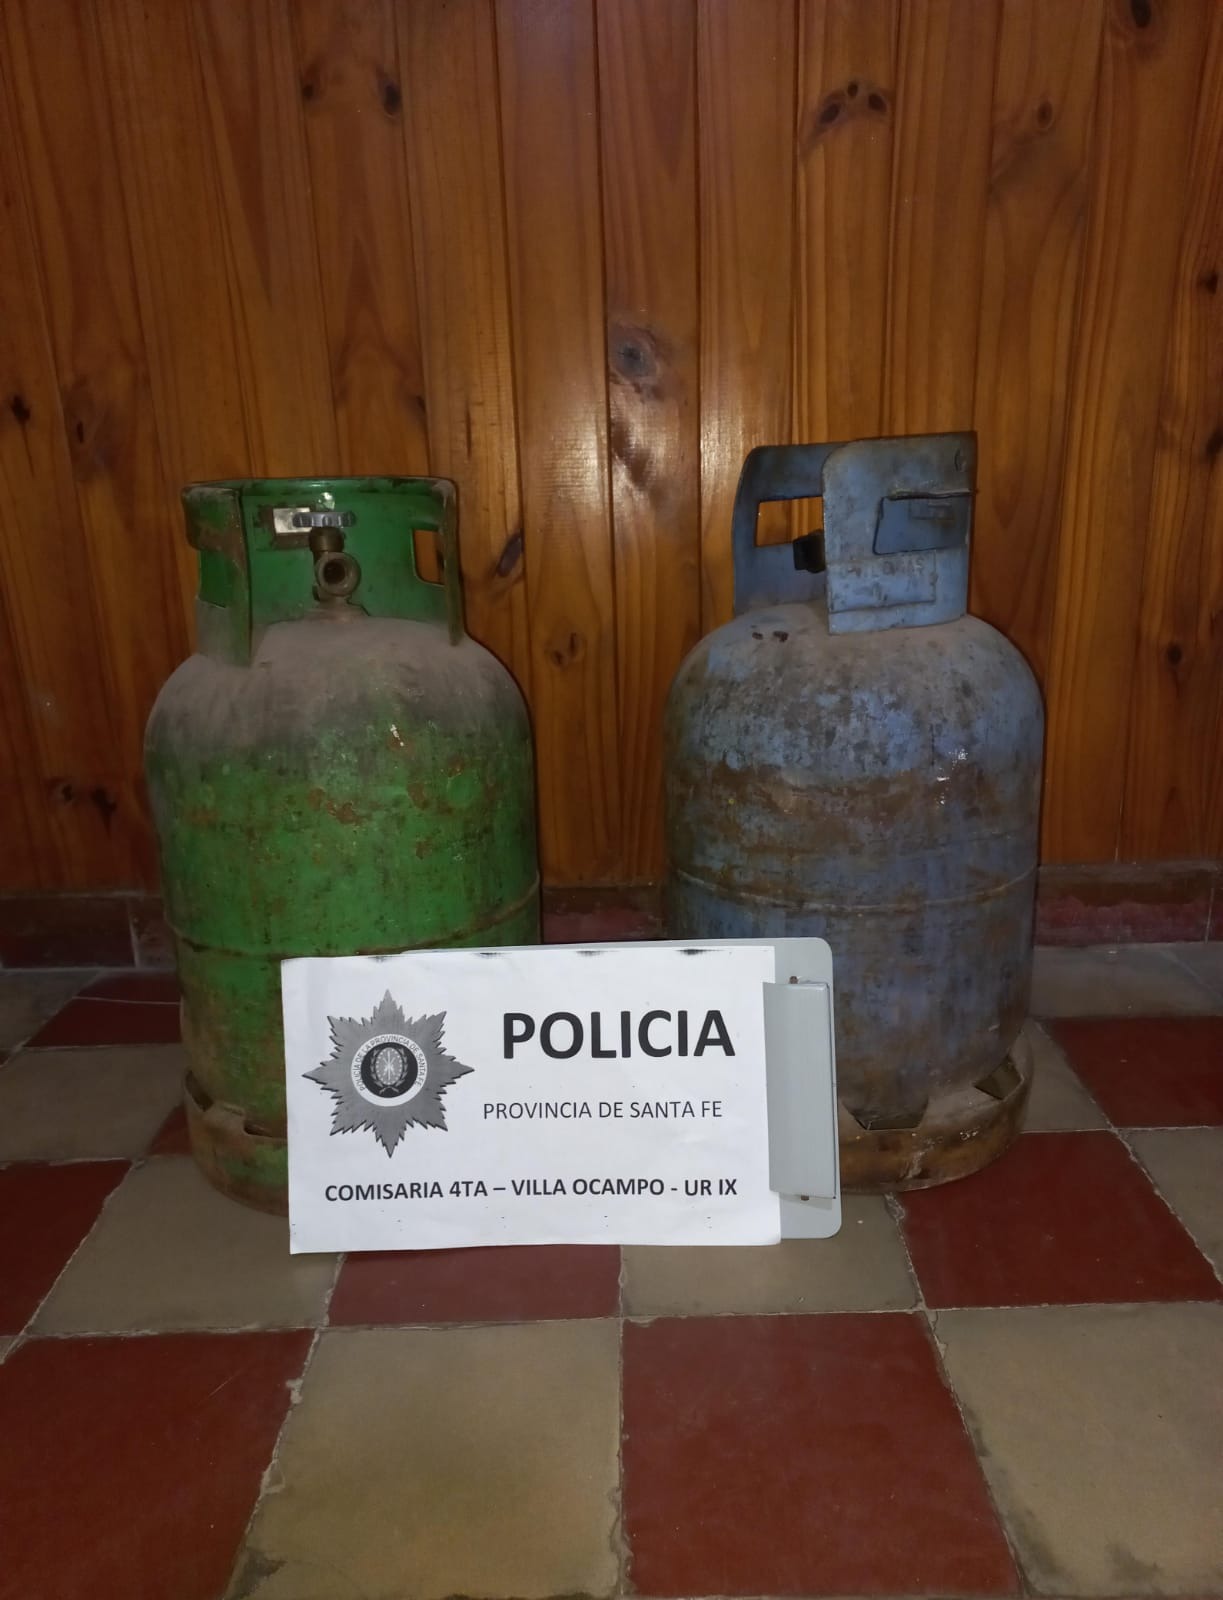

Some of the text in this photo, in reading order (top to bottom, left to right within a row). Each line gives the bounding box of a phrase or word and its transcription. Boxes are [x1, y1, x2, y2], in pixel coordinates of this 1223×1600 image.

[503, 1010, 735, 1059] POLICIA
[371, 1035, 410, 1046] PROVINCIA
[417, 1053, 426, 1076] SANTA
[483, 1100, 721, 1119] PROVINCIA DE SANTA FE
[324, 1182, 443, 1201] COMISARIA
[449, 1180, 487, 1197] 4TA
[511, 1179, 566, 1195] VILLA
[572, 1178, 664, 1195] OCAMPO
[684, 1179, 712, 1196] UR
[718, 1178, 737, 1195] IX
